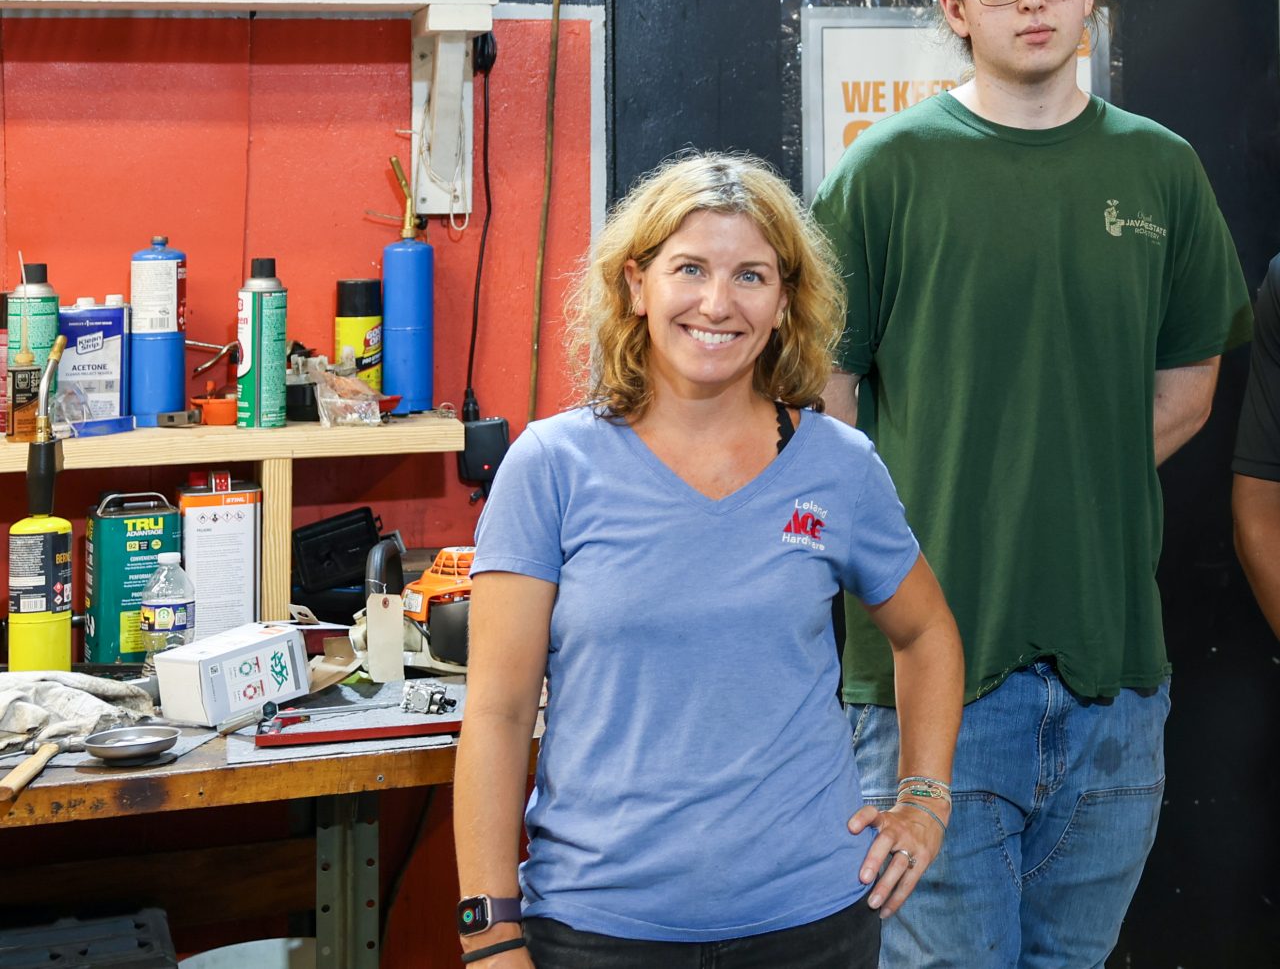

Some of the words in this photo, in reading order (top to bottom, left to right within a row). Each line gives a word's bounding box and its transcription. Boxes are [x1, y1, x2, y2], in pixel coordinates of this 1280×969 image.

[841, 81, 886, 113] WE
[78, 335, 102, 346] Klean
[71, 363, 108, 372] ACETONE
[795, 498, 828, 519] Leland
[124, 517, 164, 531] TRU
[783, 508, 826, 541] ACE
[126, 529, 164, 537] ADVANTAGE
[130, 554, 159, 562] CONVENIENC
